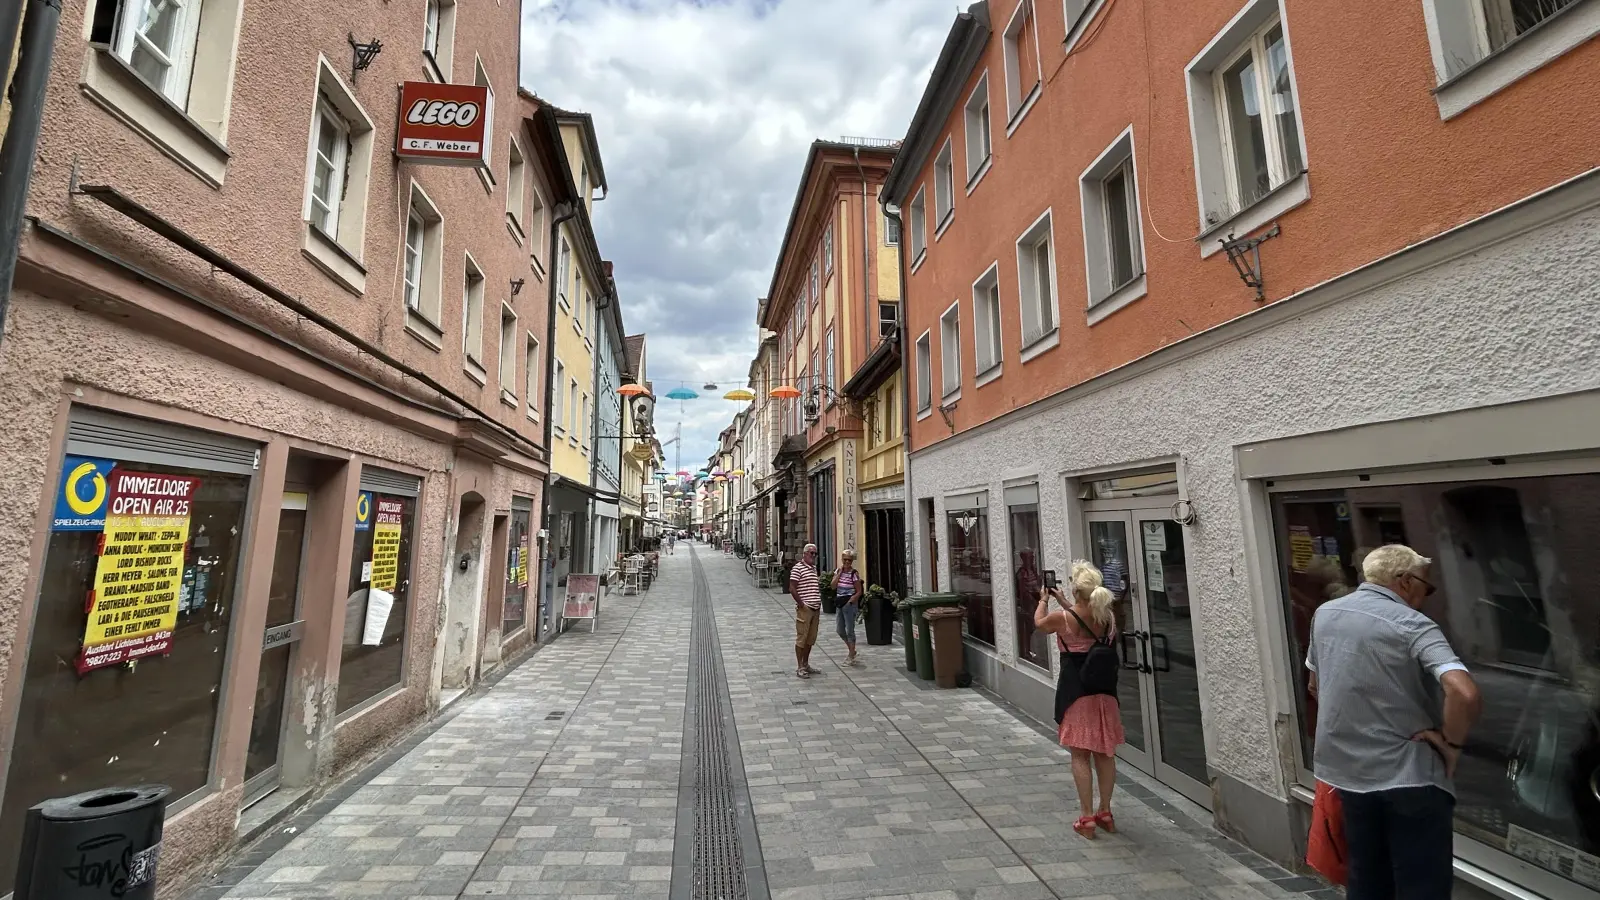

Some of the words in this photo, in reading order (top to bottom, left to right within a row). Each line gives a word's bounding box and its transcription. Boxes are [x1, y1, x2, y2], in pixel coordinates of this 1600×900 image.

[406, 99, 478, 127] LEGO
[436, 142, 471, 151] Weber
[118, 476, 191, 496] IMMELDORF
[112, 497, 150, 515] OPEN
[154, 500, 172, 515] AIR
[176, 500, 189, 516] 25
[114, 532, 137, 542] MUDDY
[104, 546, 120, 556] ANNA
[117, 558, 134, 568] LORD
[135, 556, 156, 568] BISHOP
[157, 556, 172, 565] ROCKS
[102, 572, 120, 584] HERR
[121, 570, 142, 581] MEYER
[156, 581, 170, 590] BAND
[97, 597, 139, 612] EGOTHERAPIE
[144, 592, 174, 604] FALSCHGELD
[98, 614, 112, 626] LARI
[120, 611, 132, 622] DIE
[133, 605, 170, 619] PAUSENMUSIK
[104, 625, 122, 638] EINER
[124, 622, 142, 634] FEHLT
[142, 618, 162, 630] IMMER
[267, 630, 292, 644] EINGANG
[85, 641, 114, 656] Ausfahrt
